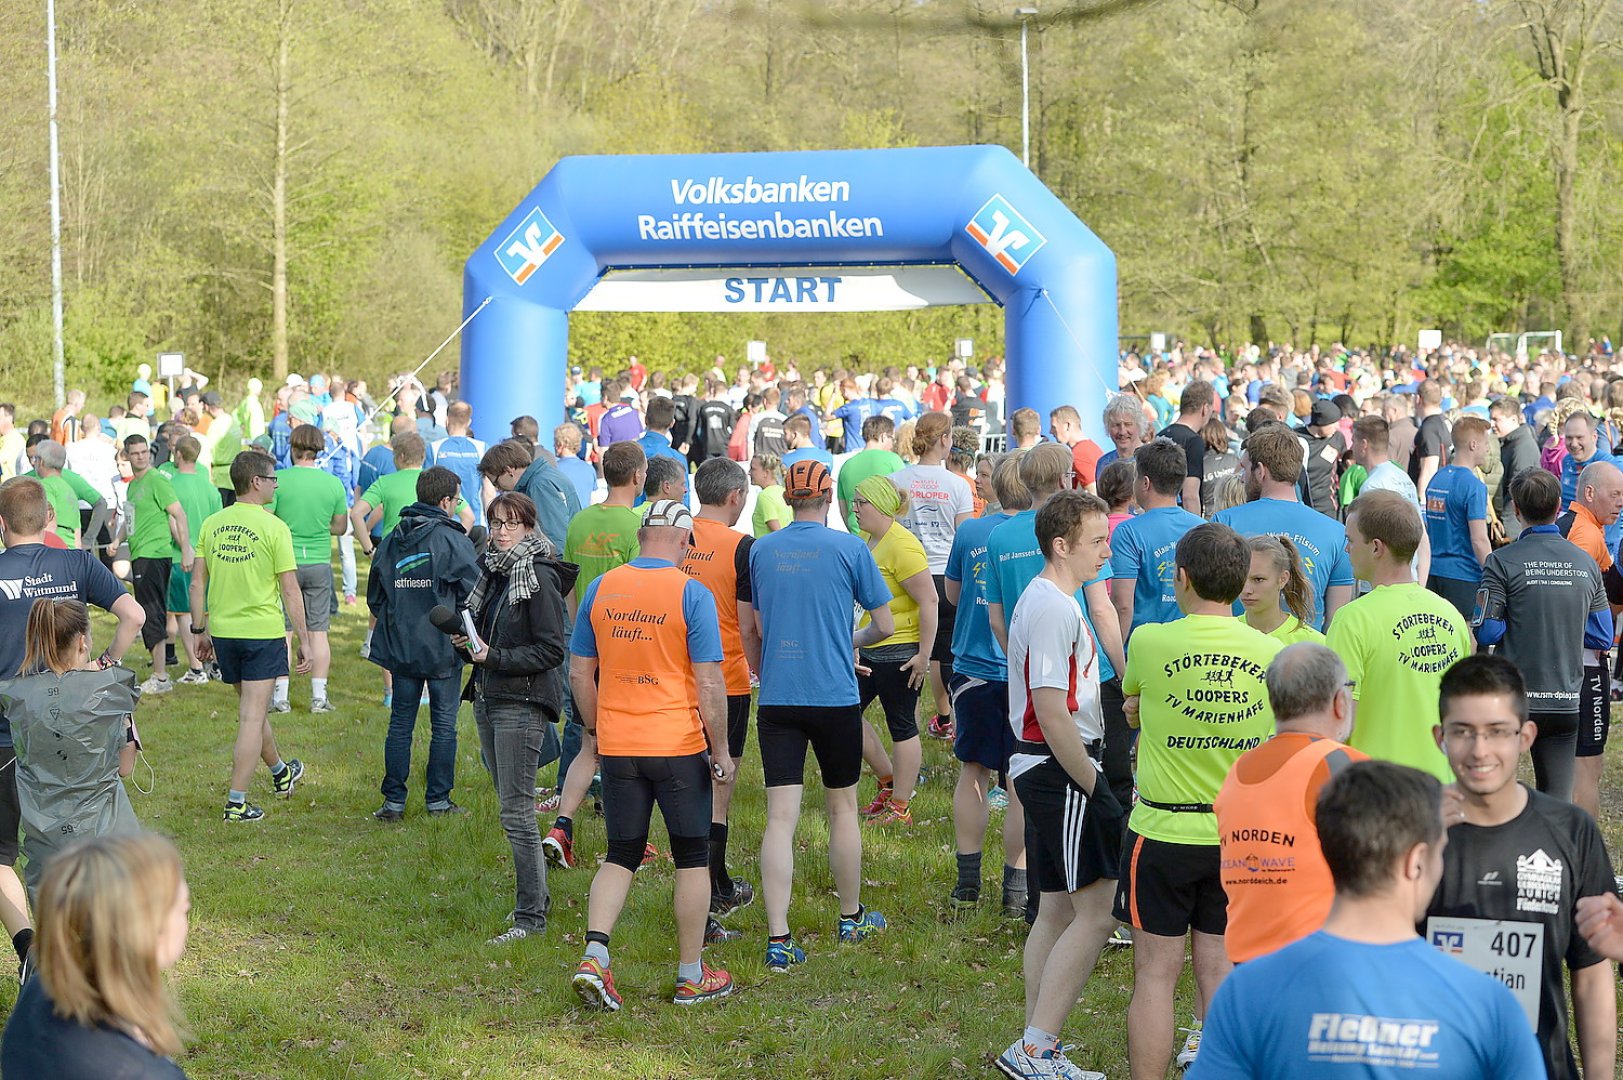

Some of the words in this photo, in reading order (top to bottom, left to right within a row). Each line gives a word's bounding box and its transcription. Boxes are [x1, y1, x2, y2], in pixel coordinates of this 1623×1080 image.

[671, 175, 849, 205] Volksbanken
[637, 210, 884, 240] Raiffeisenbanken
[724, 277, 842, 303] START
[1011, 549, 1035, 559] Janssen
[1525, 569, 1546, 577] BEING
[1546, 569, 1589, 578] UNDERSTOOD
[1539, 561, 1563, 569] POWER
[24, 572, 54, 587] Stadt
[394, 577, 432, 588] stfriesen
[23, 580, 78, 598] Wittmund
[602, 607, 667, 626] Nordland
[611, 625, 653, 642] läuft...
[1392, 612, 1455, 641] STÖRTEBEKER
[1410, 643, 1447, 658] LOOPERS
[1164, 652, 1267, 684] STÖRTEBEKER
[1398, 651, 1411, 665] TV
[1410, 647, 1459, 674] MARIENHAFE
[638, 673, 659, 685] BSG
[1589, 674, 1602, 692] TV
[1186, 689, 1249, 704] LOOPERS
[1165, 693, 1182, 708] TV
[1181, 698, 1265, 724] MARIENHAFE
[1592, 696, 1604, 741] Norden
[1167, 735, 1260, 750] DEUTSCHLAND
[1231, 829, 1295, 848] NORDEN
[1261, 856, 1296, 868] WAVE
[1517, 888, 1560, 901] AURICH
[1490, 931, 1537, 958] 407
[1487, 967, 1525, 990] tian
